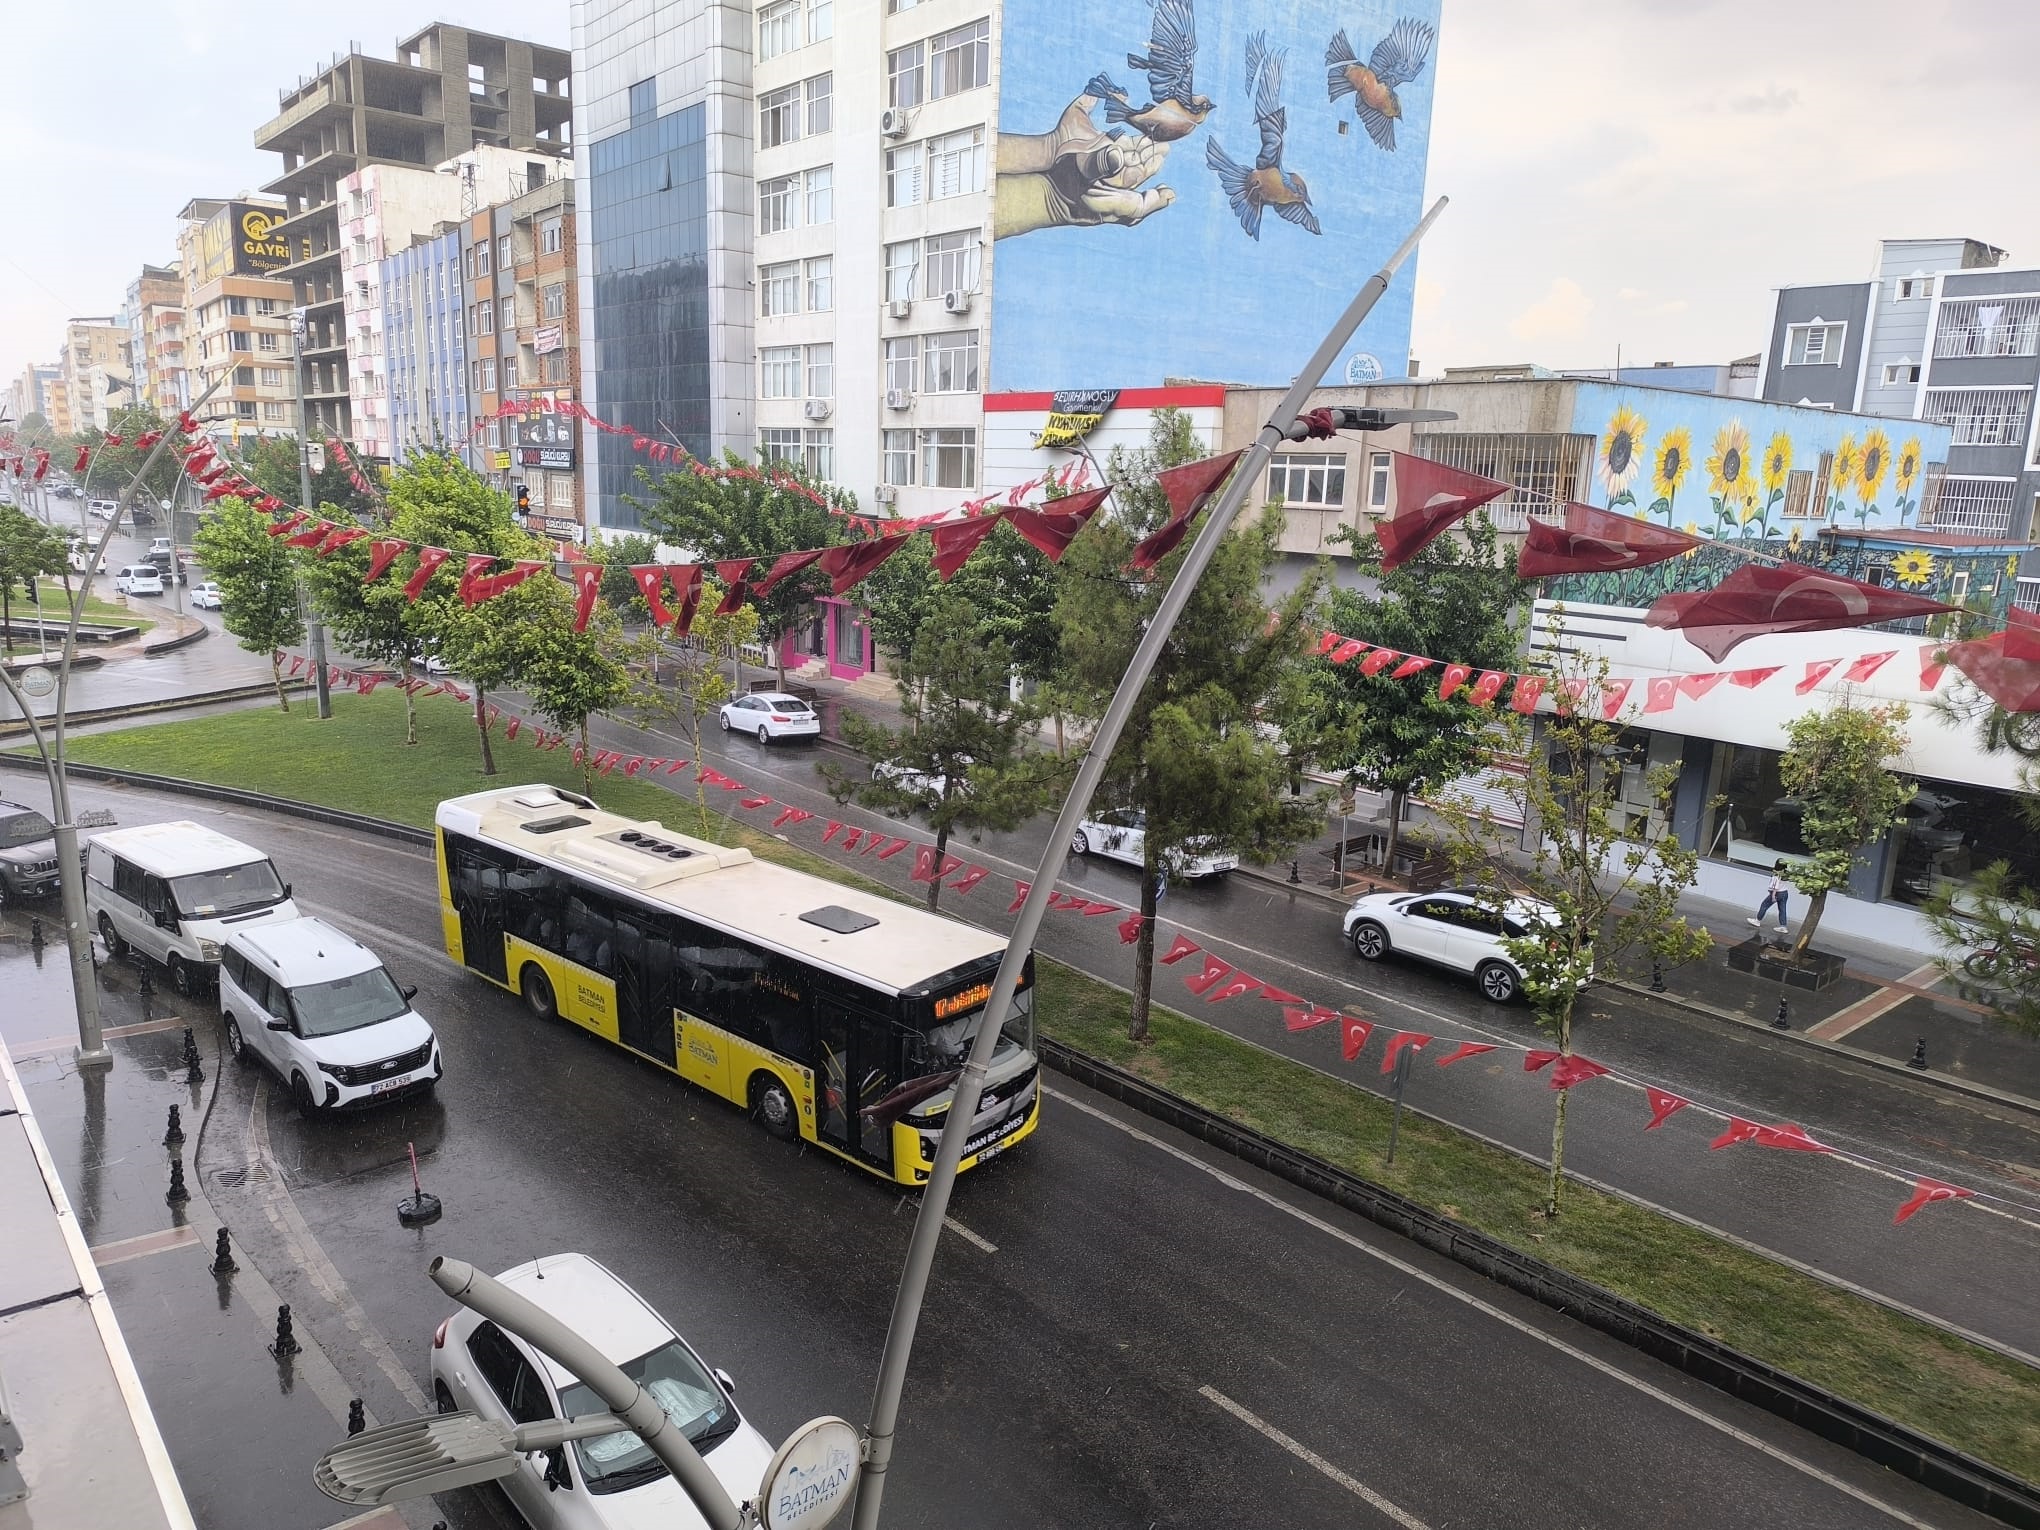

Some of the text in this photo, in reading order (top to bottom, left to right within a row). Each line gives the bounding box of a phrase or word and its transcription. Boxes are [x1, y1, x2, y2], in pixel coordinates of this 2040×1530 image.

[578, 984, 605, 1003] BATMAN
[688, 1042, 719, 1065] BATMAN
[960, 1136, 988, 1156] TMAN
[778, 1463, 850, 1517] BATMAN
